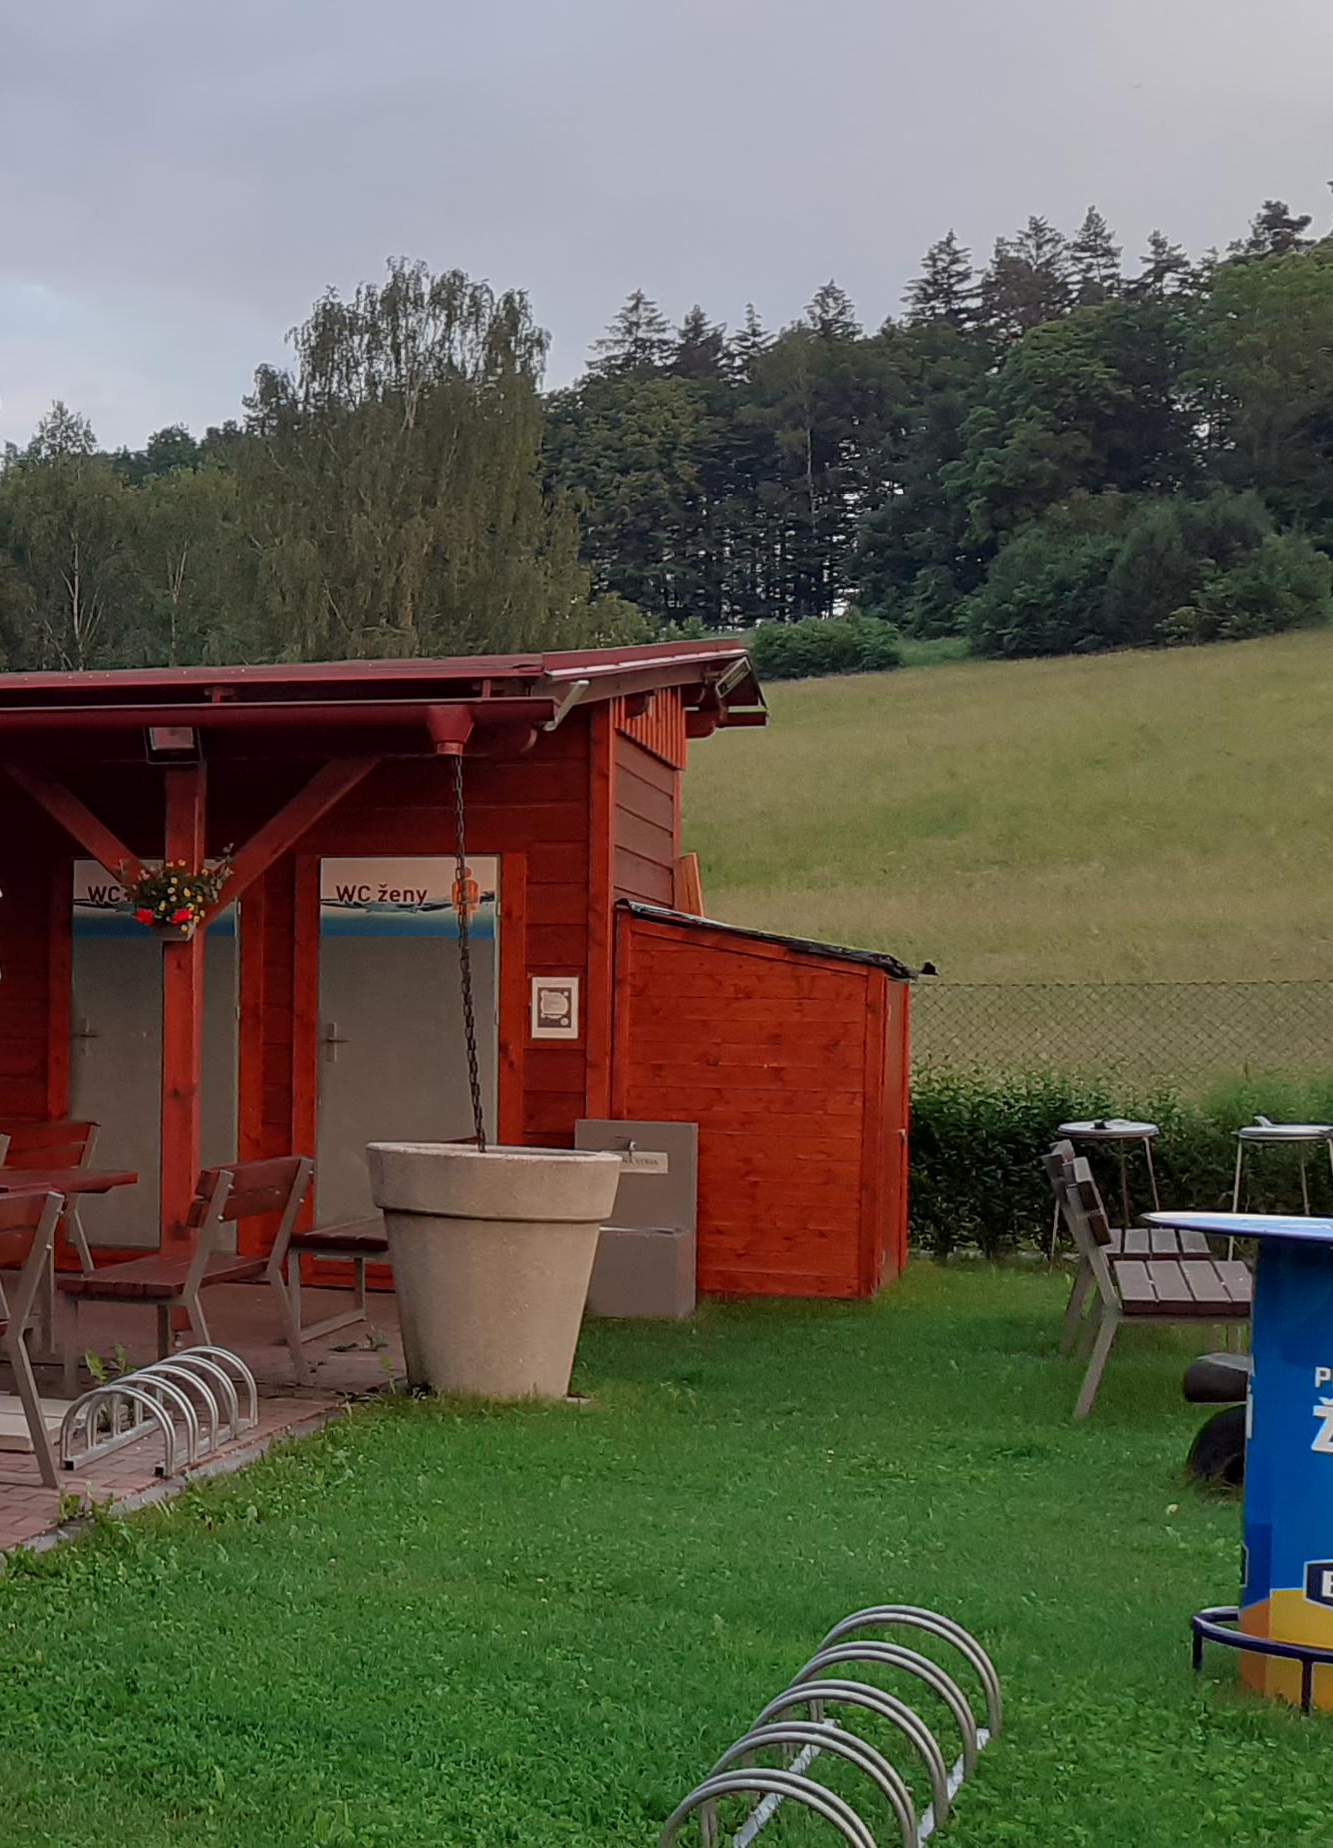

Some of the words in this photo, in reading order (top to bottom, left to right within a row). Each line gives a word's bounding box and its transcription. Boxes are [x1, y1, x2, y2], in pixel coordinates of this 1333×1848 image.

[88, 886, 120, 902] WC
[336, 885, 370, 902] WC
[377, 883, 428, 906] ženy
